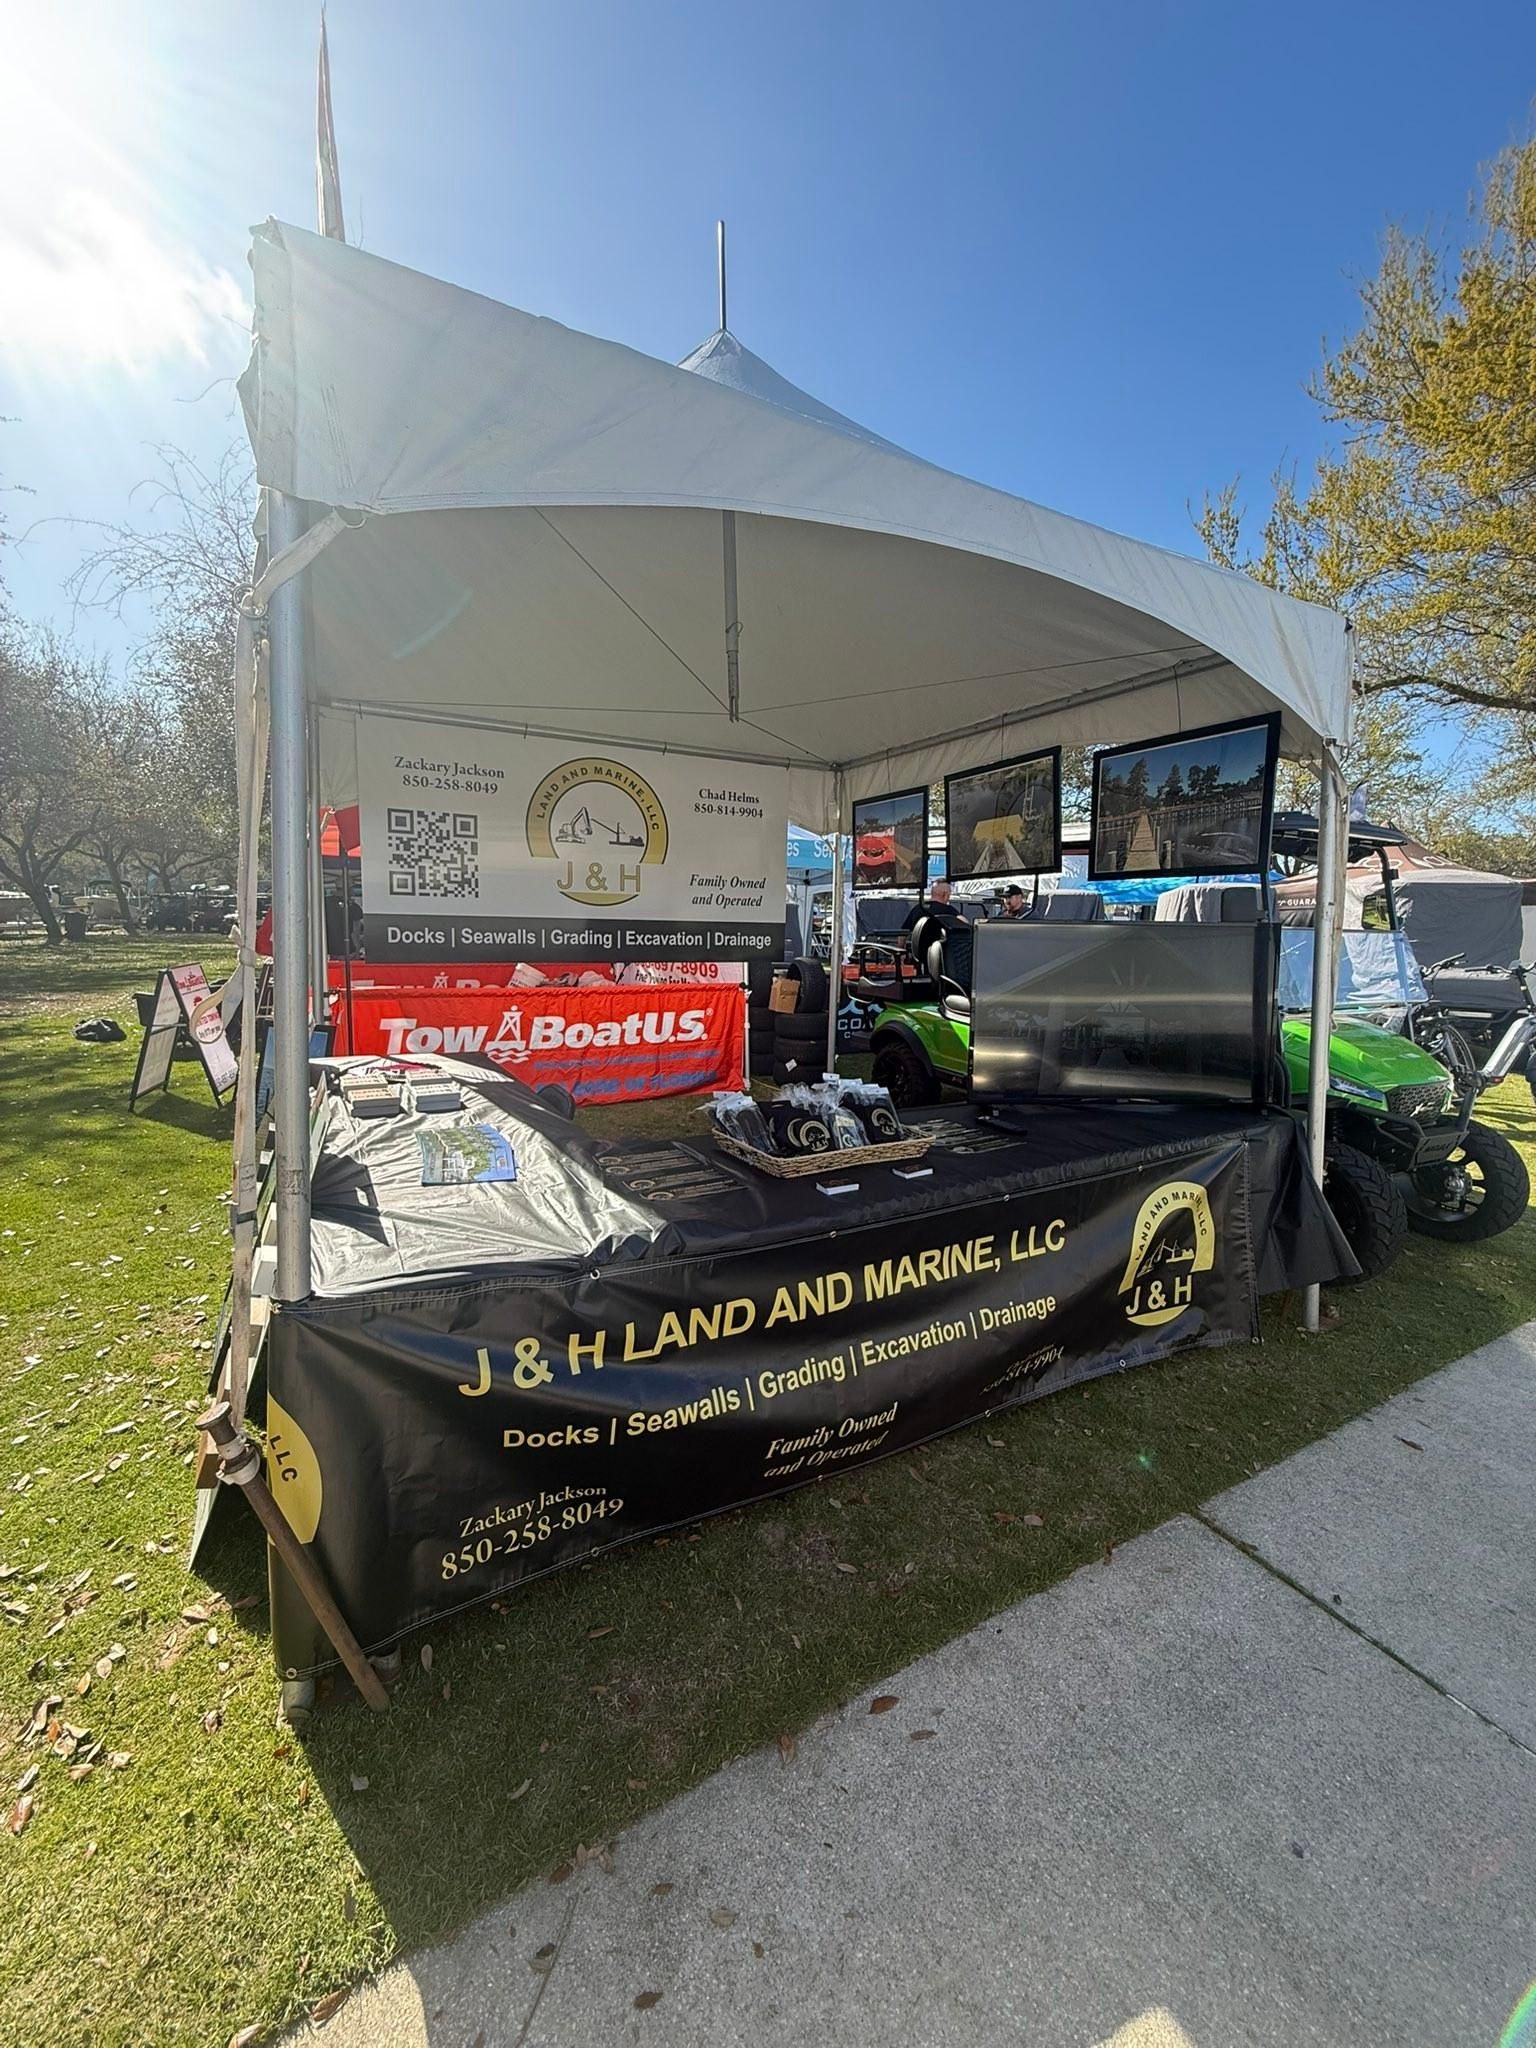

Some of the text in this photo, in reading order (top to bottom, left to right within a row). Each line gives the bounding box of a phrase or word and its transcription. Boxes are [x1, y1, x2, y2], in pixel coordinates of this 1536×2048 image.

[394, 756, 505, 779] Zackary Jackson
[402, 774, 498, 794] 850-258-8049
[536, 766, 660, 831] LAND AND MARINE, LLC
[694, 802, 763, 818] 850-814-9904
[698, 788, 760, 804] Chad Helms
[556, 861, 641, 892] J & H
[690, 874, 767, 891] Family Owned
[692, 893, 763, 910] and Operated
[387, 926, 446, 944] Docks
[461, 928, 536, 945] Seawalls
[550, 929, 613, 949] Grading
[626, 930, 703, 946] Excavation
[714, 932, 772, 950] Drainage
[379, 1018, 488, 1055] Tow
[1151, 1196, 1169, 1219] AND
[1198, 1212, 1208, 1237] LLC
[458, 1218, 1066, 1397] J & H LAND AND MARINE, LLC
[1125, 1274, 1192, 1316] J & H
[503, 1424, 600, 1448] Docks
[626, 1386, 742, 1436] Seawalls
[758, 1354, 846, 1400] Grading
[860, 1318, 967, 1366] Excavation
[979, 1294, 1057, 1332] Drainage
[764, 1400, 899, 1460] Family Owned
[270, 1435, 298, 1482] LLC
[764, 1430, 890, 1478] and Operated
[459, 1486, 608, 1538] Zackary Jackson
[440, 1498, 625, 1580] 850-258-8049
